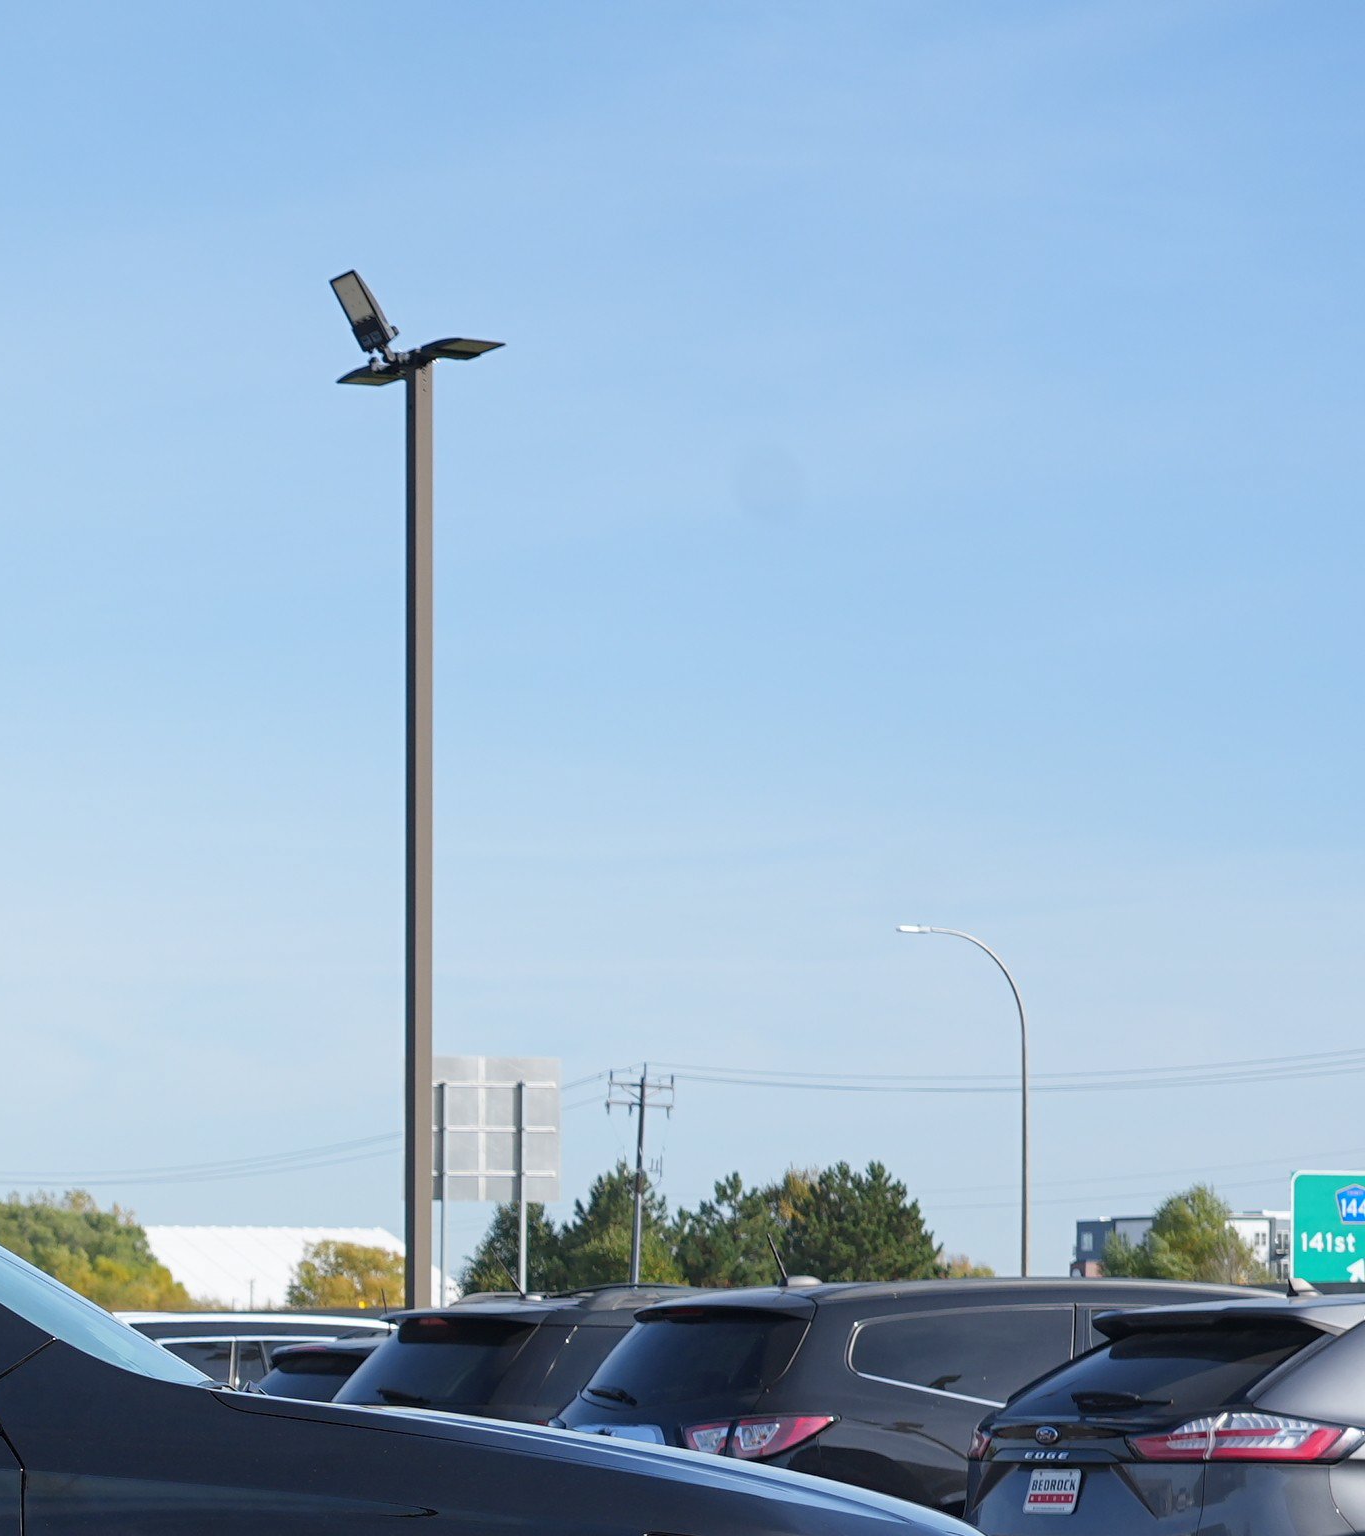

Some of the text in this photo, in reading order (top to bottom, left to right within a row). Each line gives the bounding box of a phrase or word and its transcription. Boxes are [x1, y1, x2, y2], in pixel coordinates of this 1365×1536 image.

[1301, 1231, 1356, 1254] 141st
[1024, 1451, 1069, 1460] EDGE
[1031, 1480, 1077, 1492] BEDROCK
